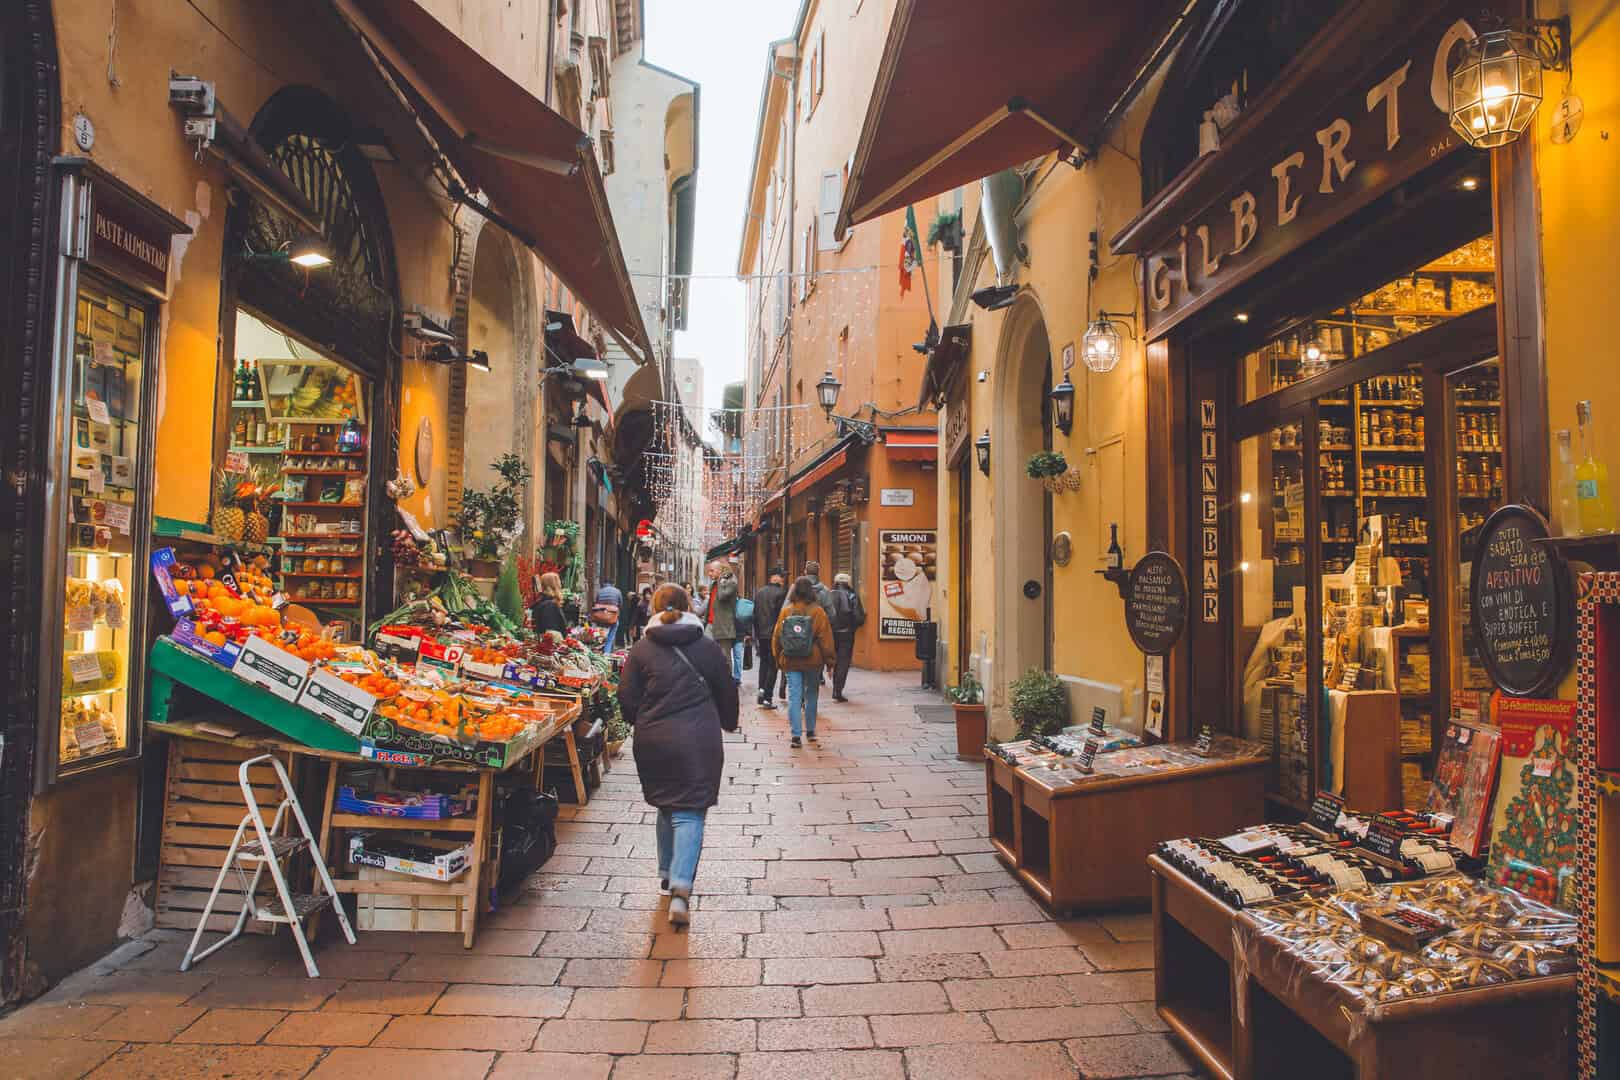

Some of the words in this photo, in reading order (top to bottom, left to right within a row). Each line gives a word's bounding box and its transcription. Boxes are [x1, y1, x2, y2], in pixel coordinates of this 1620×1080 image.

[96, 212, 122, 247] PASTE
[124, 232, 166, 271] ALIMENTARI
[890, 534, 927, 542] SIMONI
[1487, 566, 1541, 590] APERITIVO
[883, 618, 914, 628] PARMIGI
[1508, 620, 1539, 636] BUFFET
[353, 852, 385, 868] Melinda
